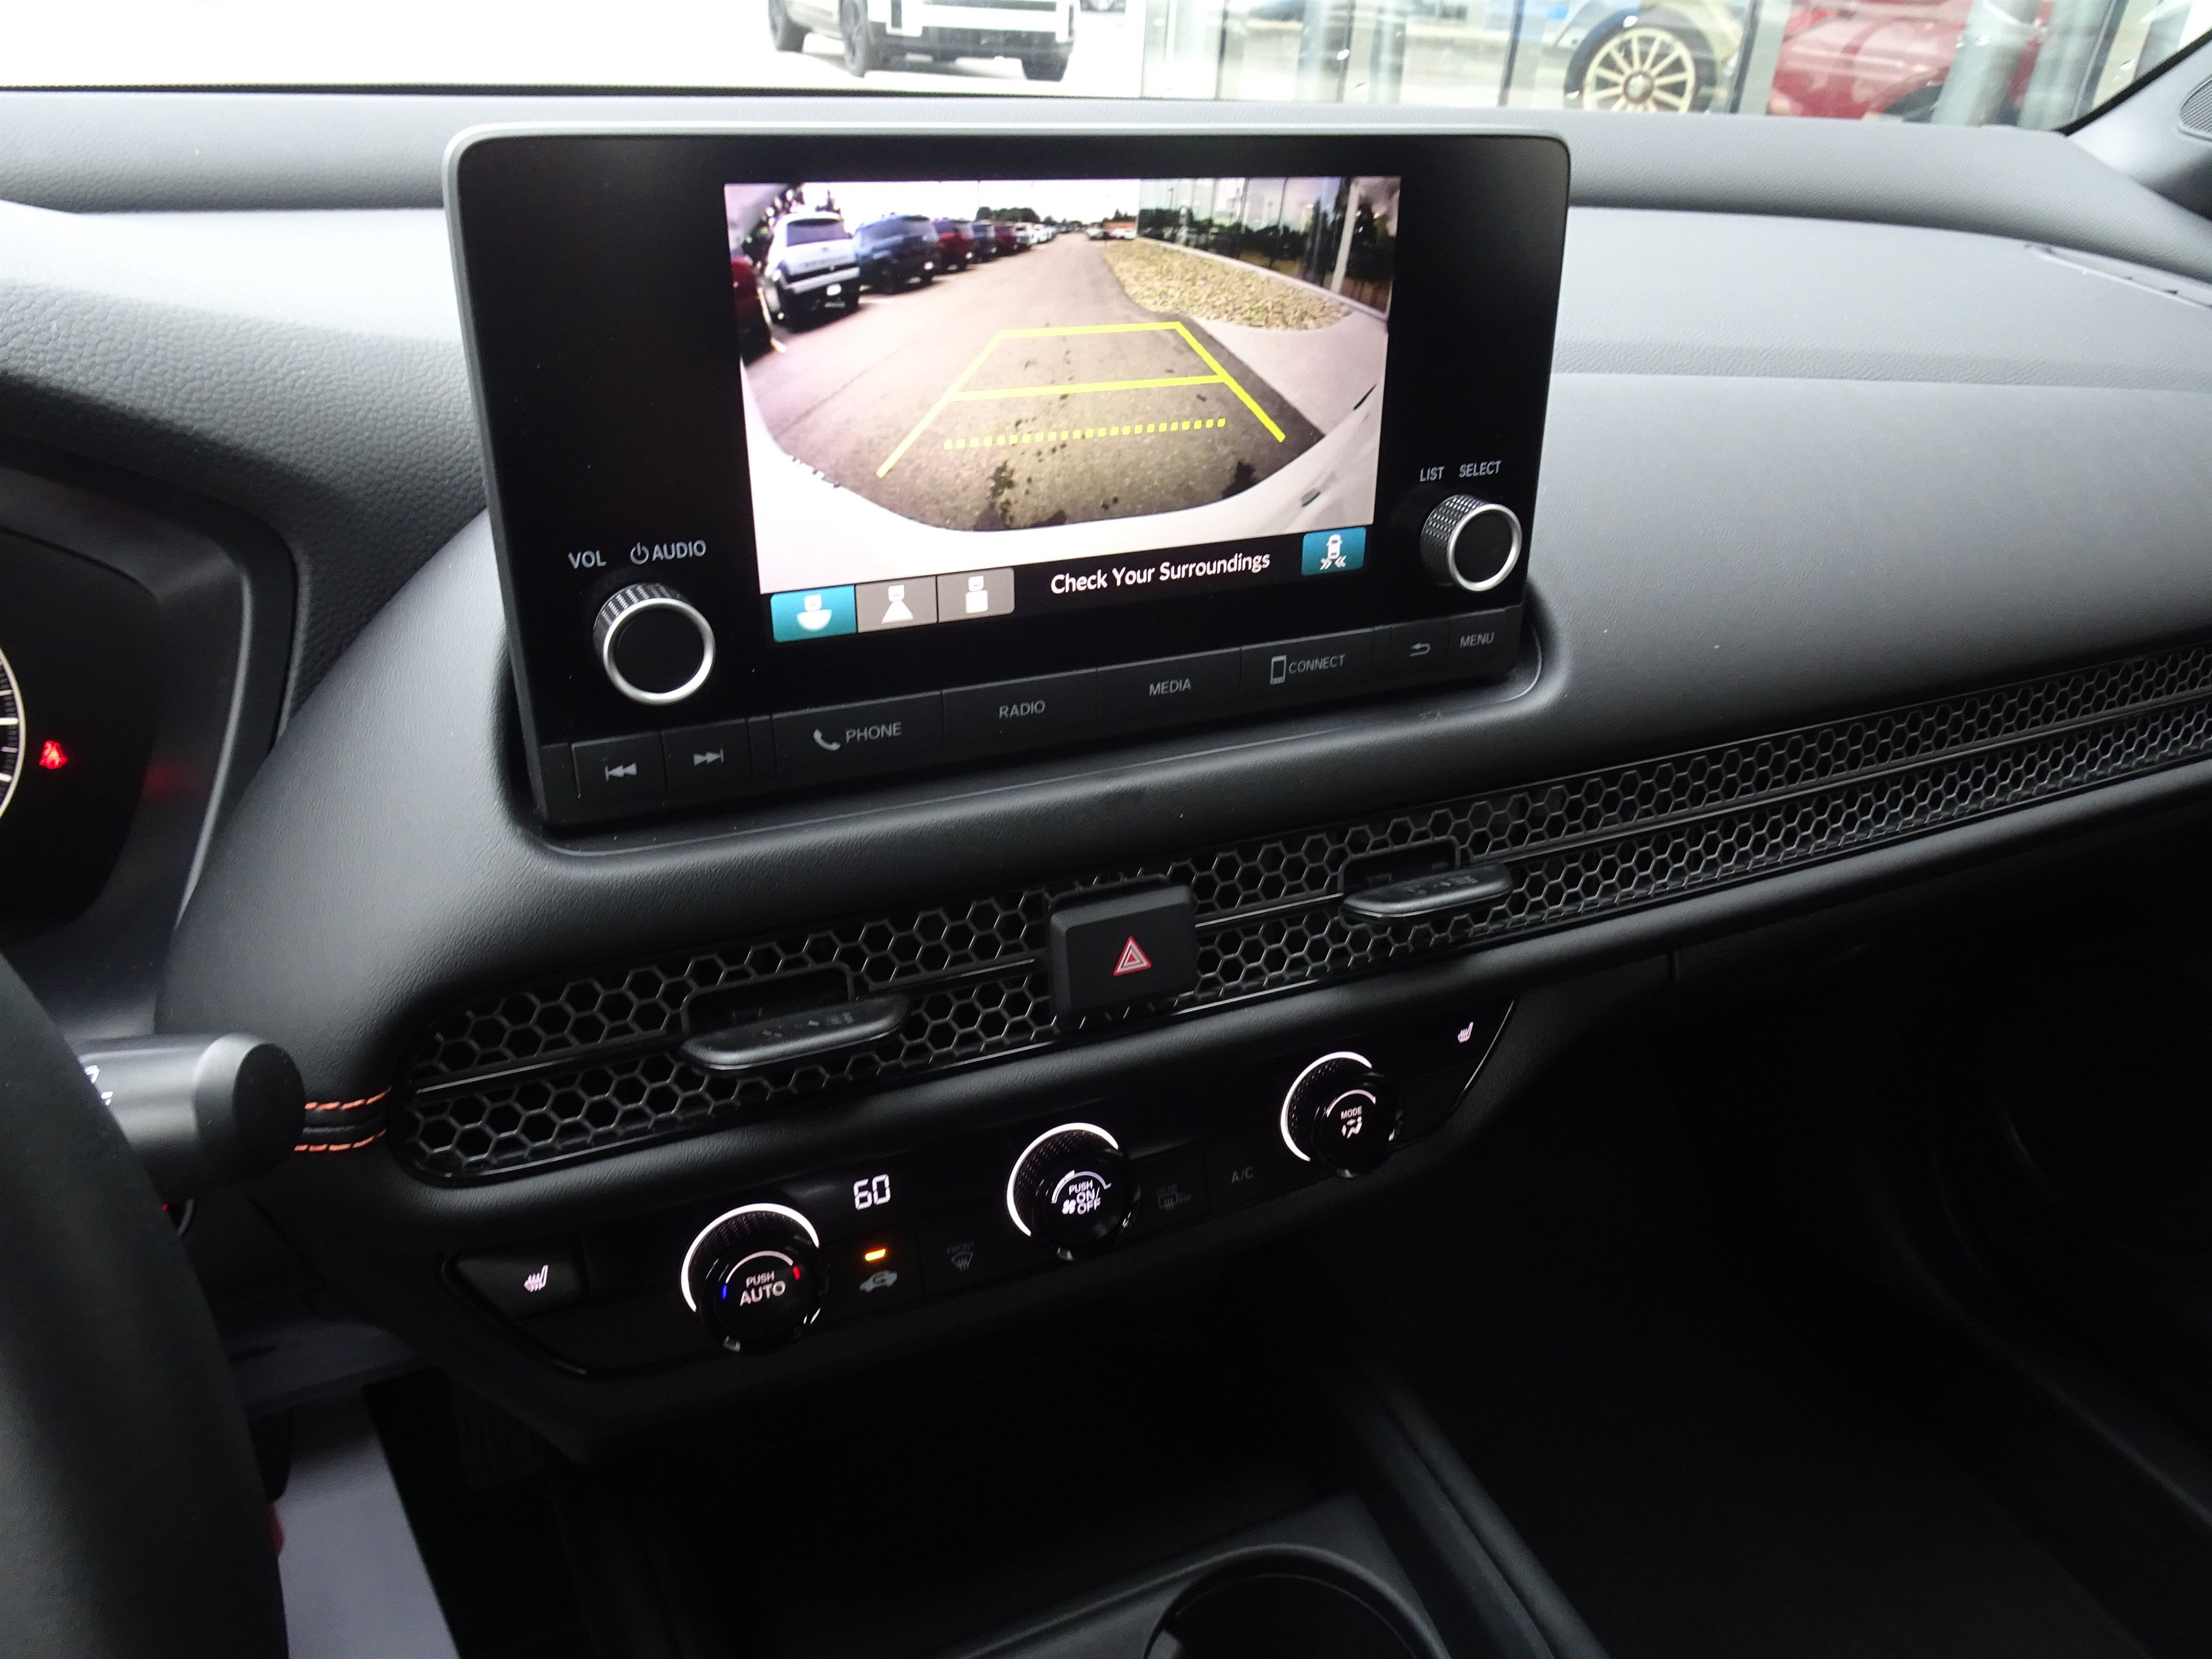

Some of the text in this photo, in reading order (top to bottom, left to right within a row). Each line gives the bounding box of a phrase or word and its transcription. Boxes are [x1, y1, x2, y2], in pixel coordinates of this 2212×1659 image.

[1420, 467, 1445, 482] LIST
[1459, 461, 1501, 477] SELECT
[568, 550, 606, 569] VOL
[652, 539, 706, 561] AUDIO
[1051, 552, 1270, 594] Check Your Surroundings
[1460, 631, 1495, 648] MENU
[1289, 654, 1345, 675] CONNECT
[1149, 678, 1191, 697] MEDIA
[999, 700, 1046, 719] RADIO
[846, 721, 902, 743] PHONE
[1341, 1106, 1363, 1120] MODE
[1231, 1166, 1254, 1184] A/C
[853, 1174, 891, 1210] 60
[1069, 1179, 1094, 1193] PUSH
[1077, 1198, 1101, 1214] OFF
[746, 1271, 775, 1287] PUSH
[740, 1280, 786, 1306] AUTO
